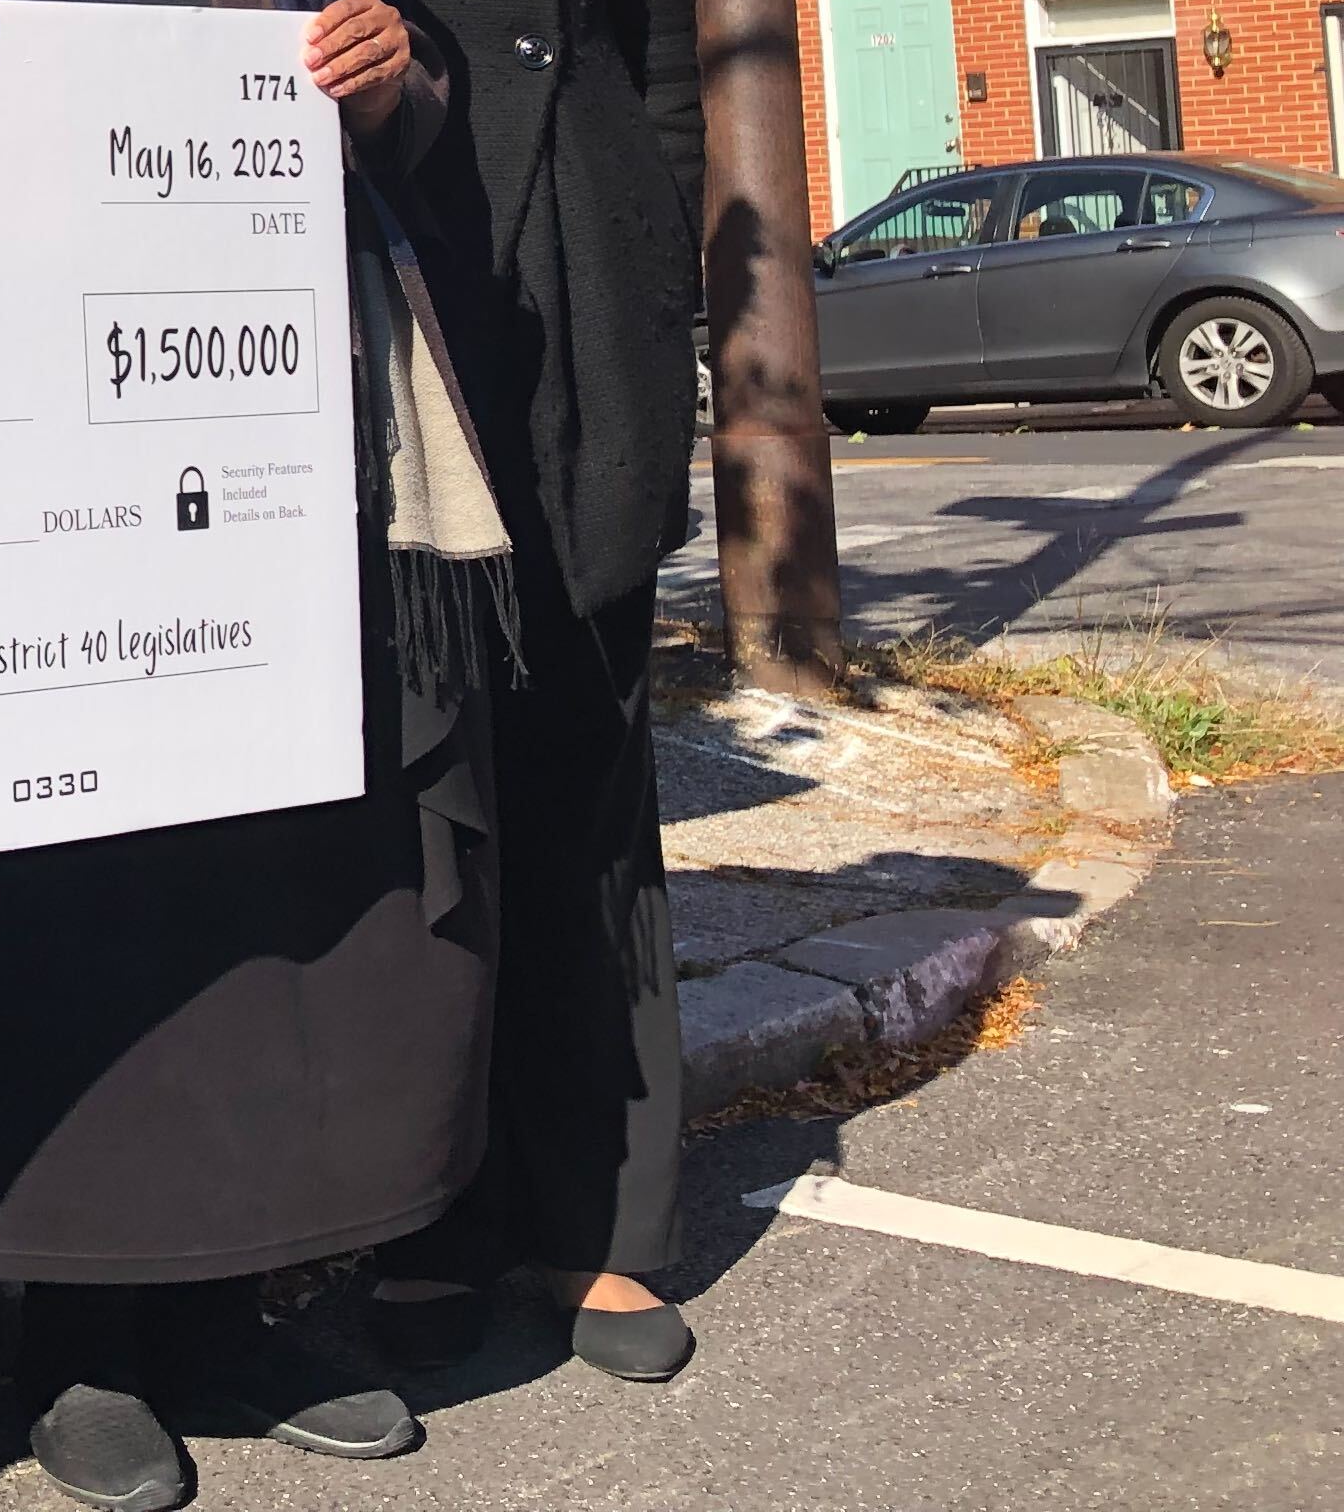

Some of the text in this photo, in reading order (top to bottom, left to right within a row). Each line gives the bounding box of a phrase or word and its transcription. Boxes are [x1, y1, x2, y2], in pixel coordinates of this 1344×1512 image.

[239, 72, 299, 102] 1774
[108, 124, 304, 199] May 16, 2023
[250, 212, 307, 235] DATE
[106, 320, 299, 400] $1,500,000
[221, 462, 313, 480] Security Features
[222, 485, 268, 501] Included
[41, 504, 143, 534] DOLLARS
[223, 508, 261, 524] Details
[262, 510, 276, 521] on
[80, 629, 108, 666] 40
[12, 769, 99, 804] 0330
